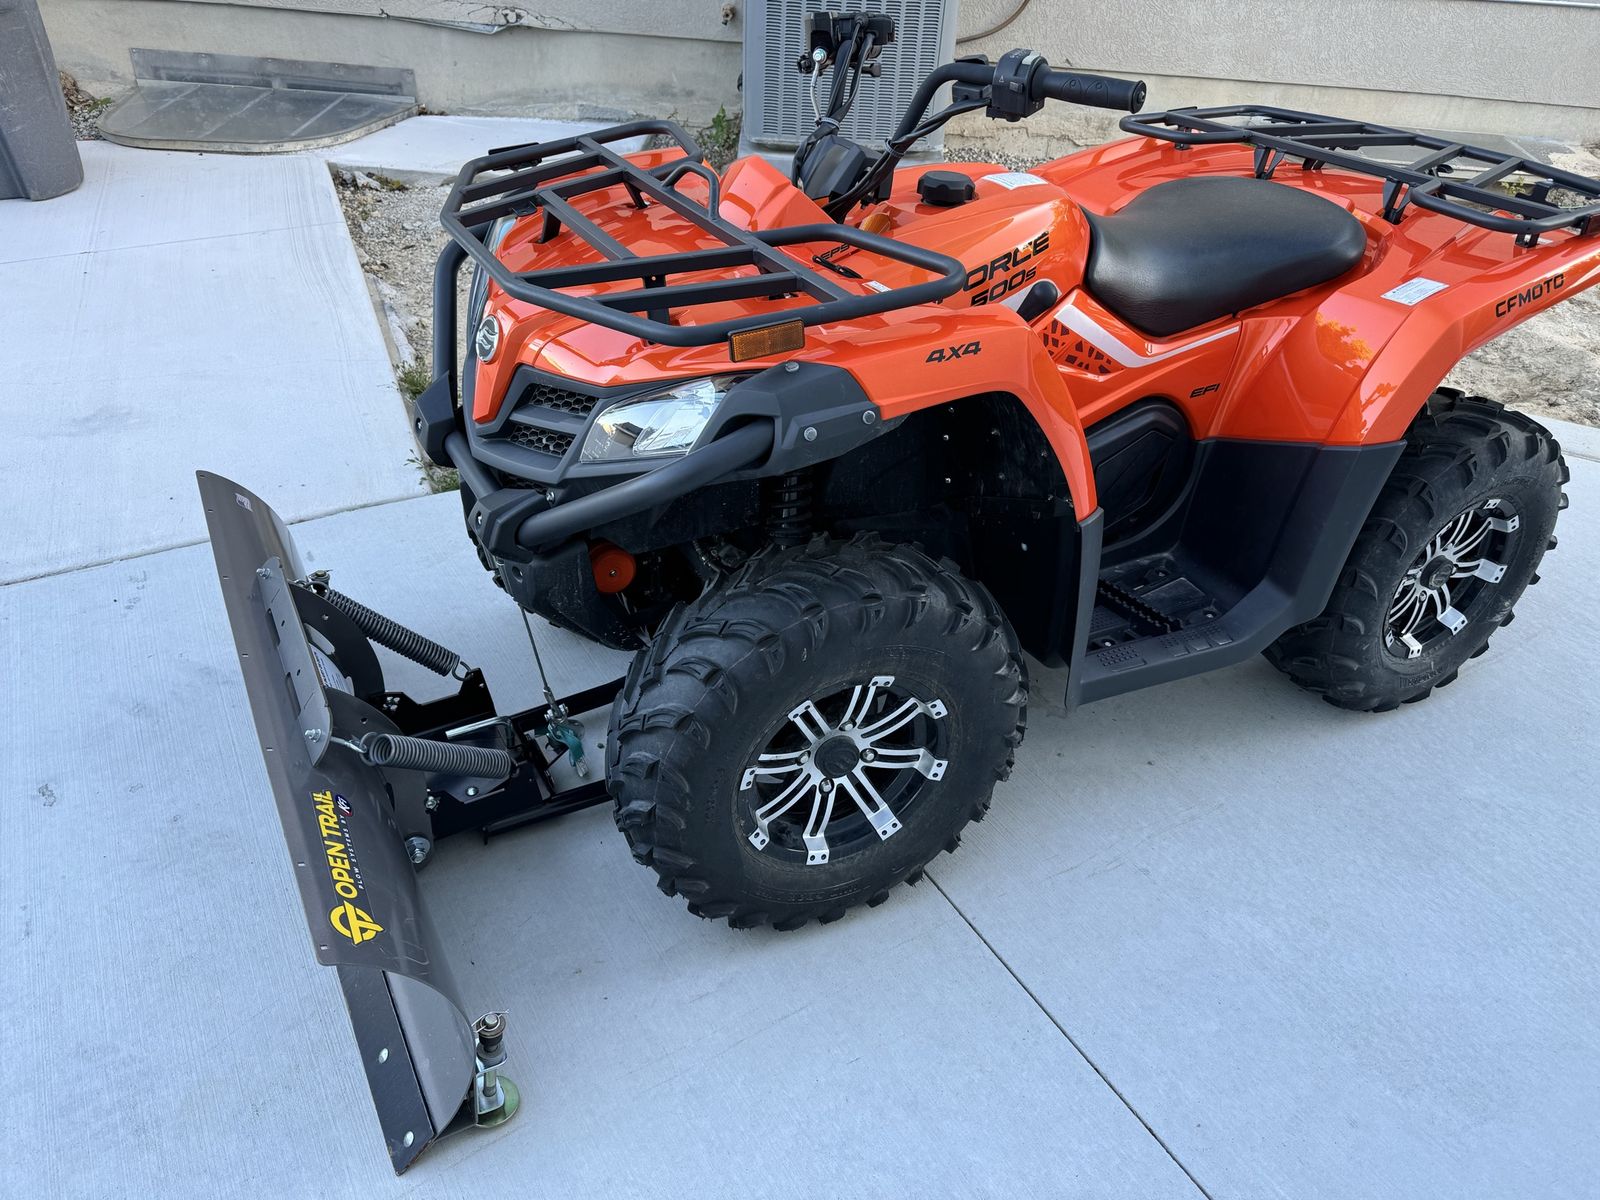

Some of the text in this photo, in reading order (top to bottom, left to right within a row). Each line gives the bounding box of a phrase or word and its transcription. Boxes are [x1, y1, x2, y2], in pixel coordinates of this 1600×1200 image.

[932, 230, 1050, 305] ORCE
[1495, 273, 1565, 318] CFMOTO
[1190, 383, 1220, 398] EFI
[339, 815, 347, 824] BY
[313, 790, 358, 899] OPEN TRAIL
[343, 828, 357, 863] SYSTEMS
[353, 866, 364, 890] PLOW
